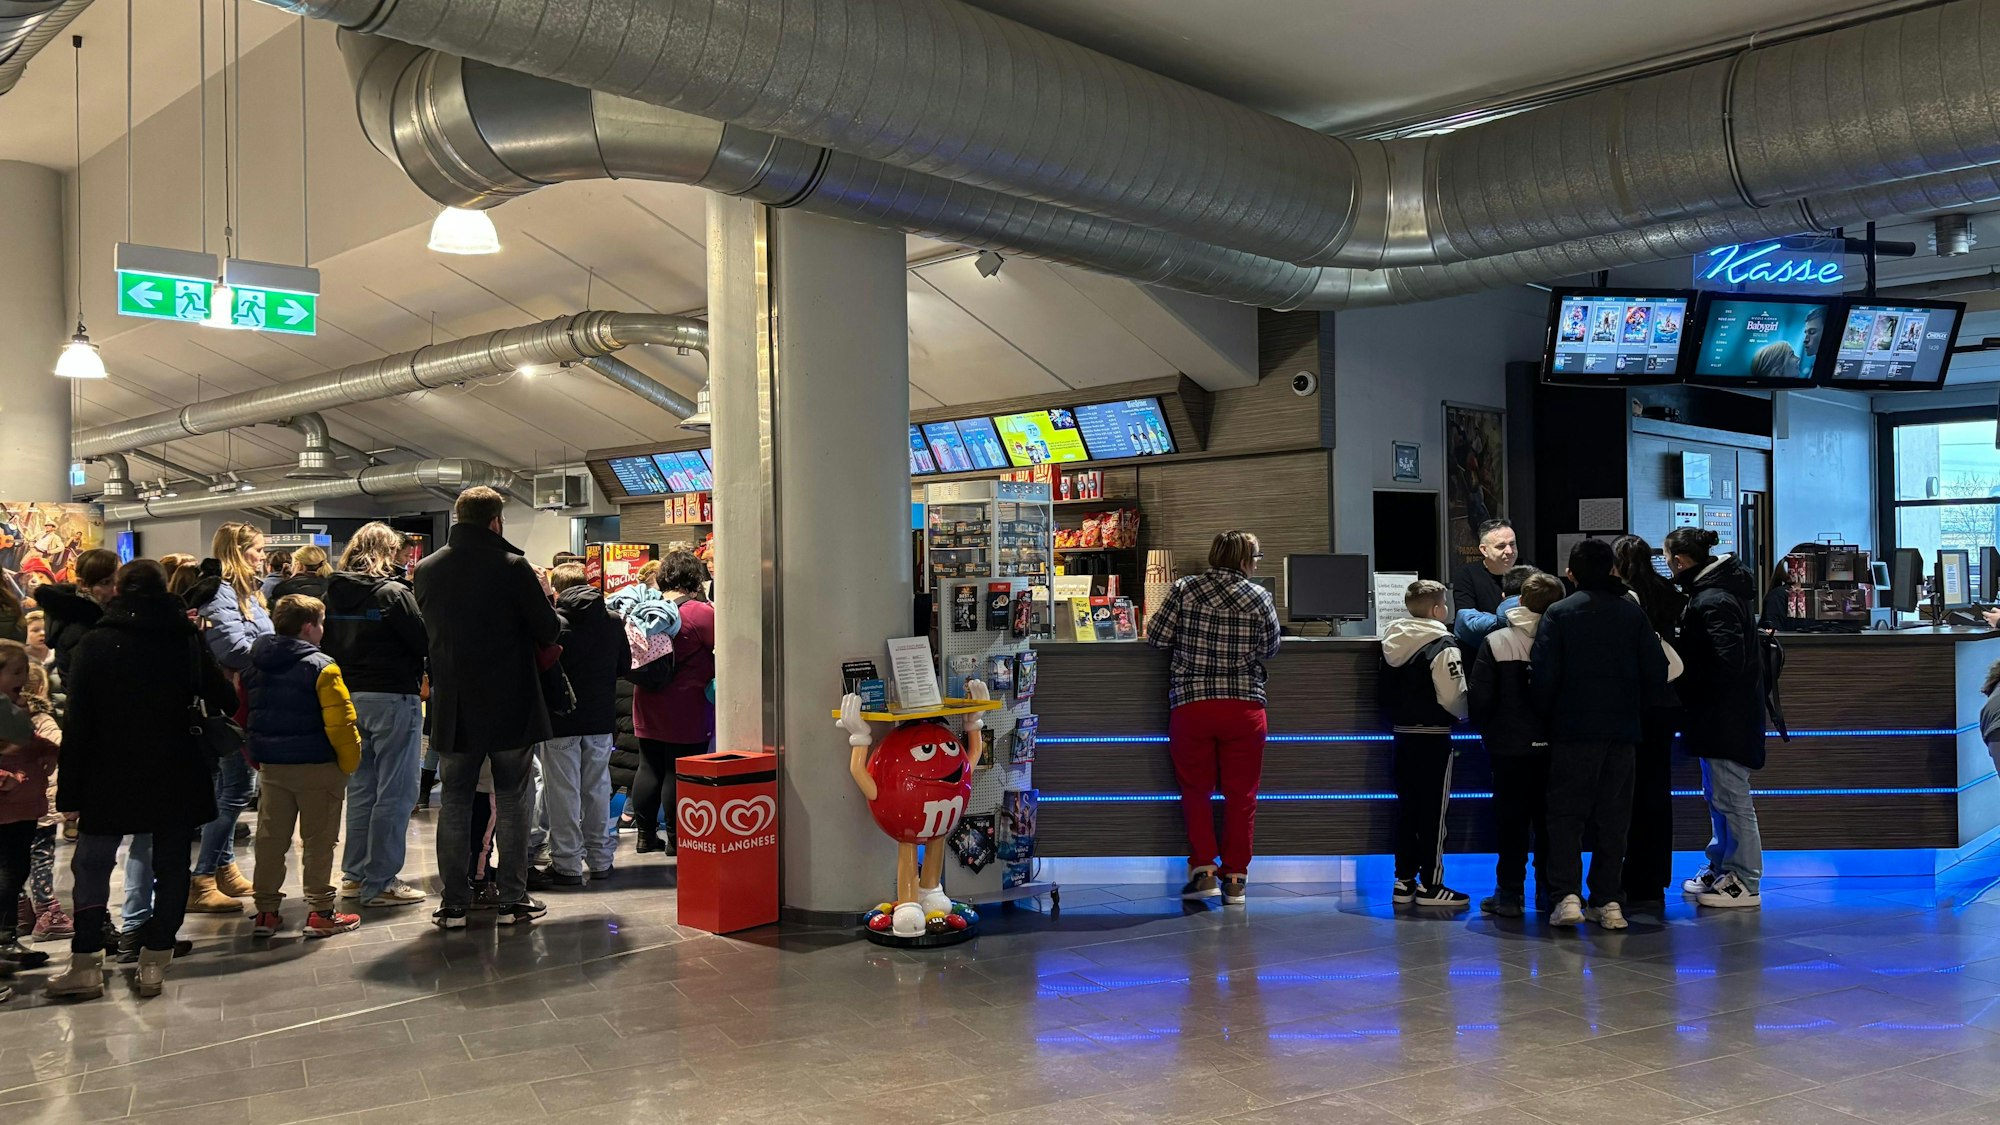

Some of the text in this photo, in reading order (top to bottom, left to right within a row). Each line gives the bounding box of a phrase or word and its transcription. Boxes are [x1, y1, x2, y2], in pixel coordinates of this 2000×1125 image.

[1707, 244, 1844, 284] Kasse
[1747, 321, 1778, 332] Babygirl
[916, 795, 964, 838] m
[678, 836, 716, 854] LANGNESE
[721, 834, 775, 854] LANGNESE
